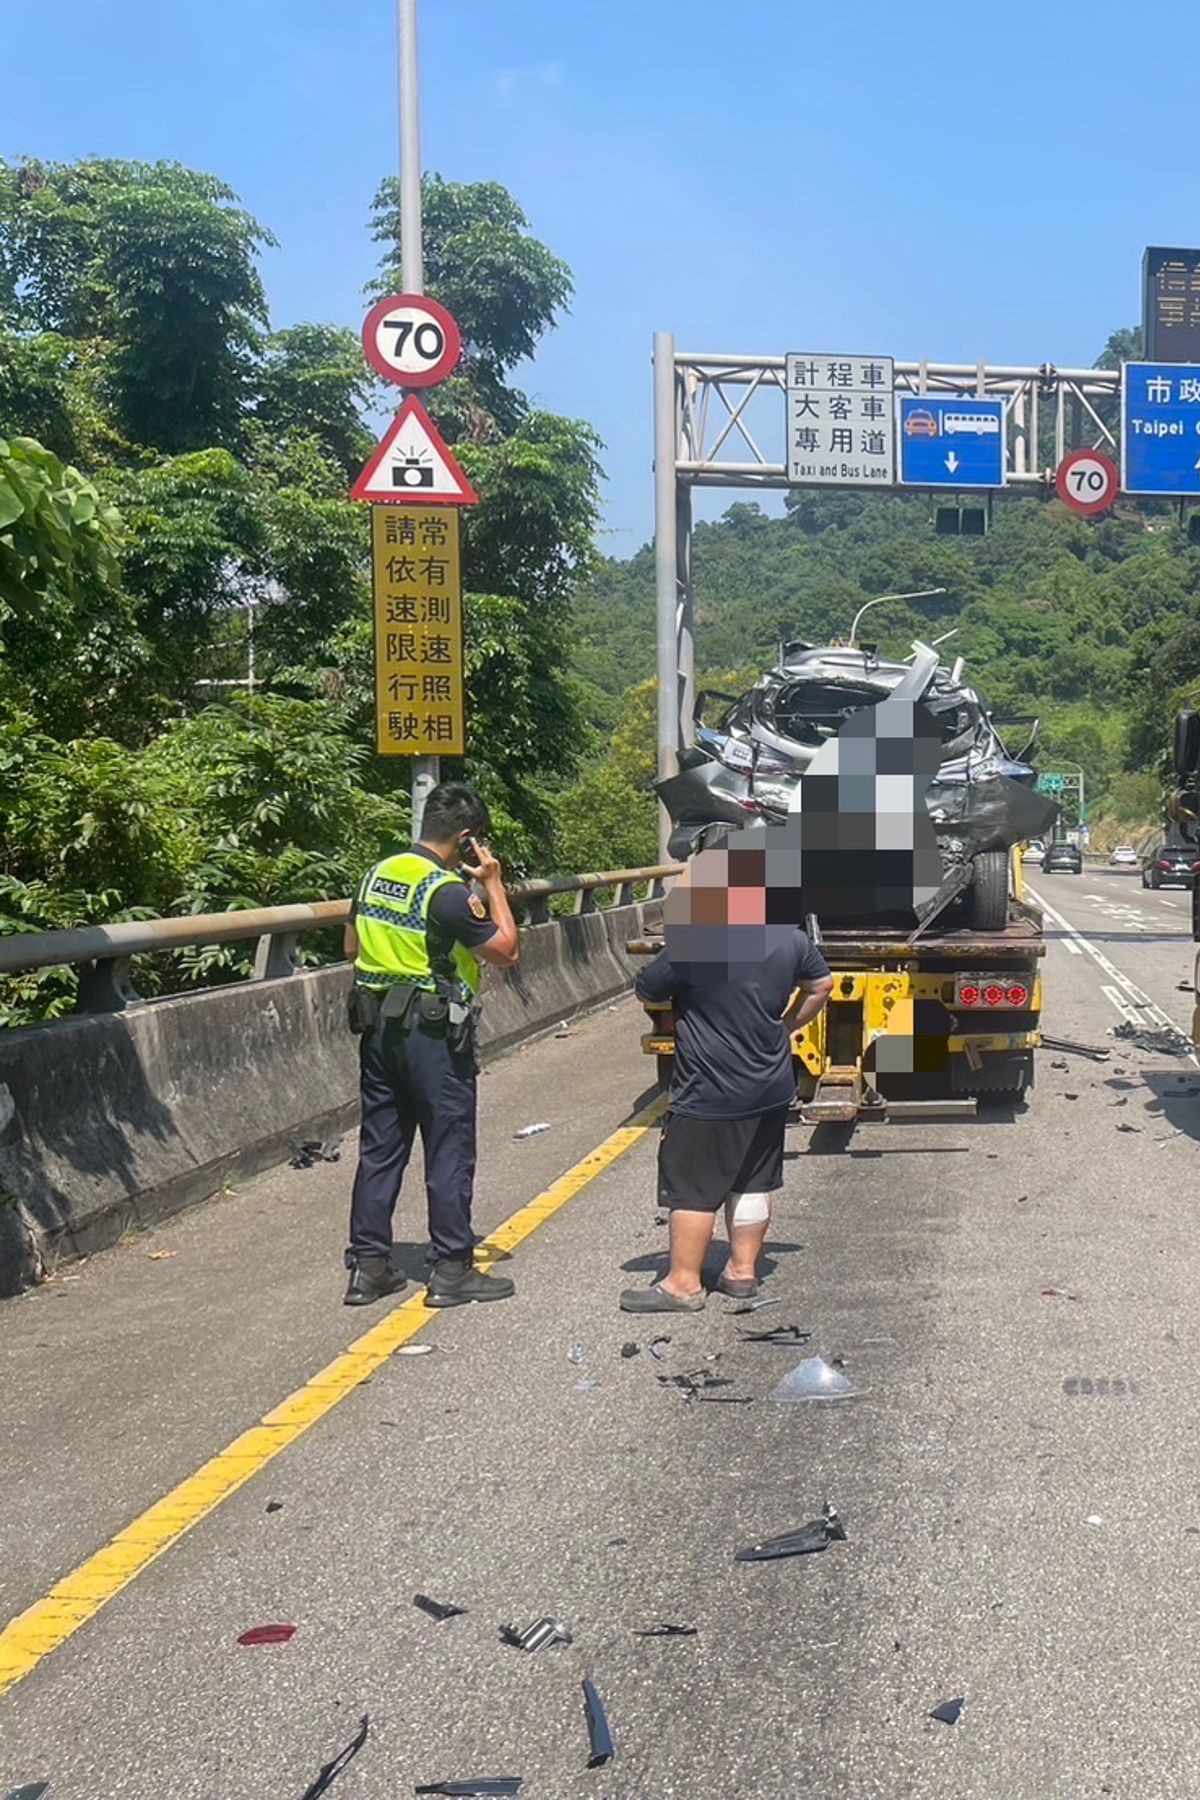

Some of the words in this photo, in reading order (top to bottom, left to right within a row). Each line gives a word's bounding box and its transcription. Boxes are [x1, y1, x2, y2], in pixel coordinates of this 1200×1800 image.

[382, 319, 445, 360] 70
[794, 361, 885, 388] 計程車
[795, 393, 885, 420] 大客車
[795, 427, 885, 455] 專用道
[1132, 419, 1184, 437] Taipei
[794, 462, 816, 476] Taxi
[820, 464, 837, 477] and
[841, 464, 860, 477] Bus
[863, 465, 888, 478] Lane
[1070, 471, 1104, 491] 70
[384, 516, 418, 741] 請依速限行駛
[419, 516, 454, 741] 常有測速照相
[373, 879, 408, 898] POLICE
